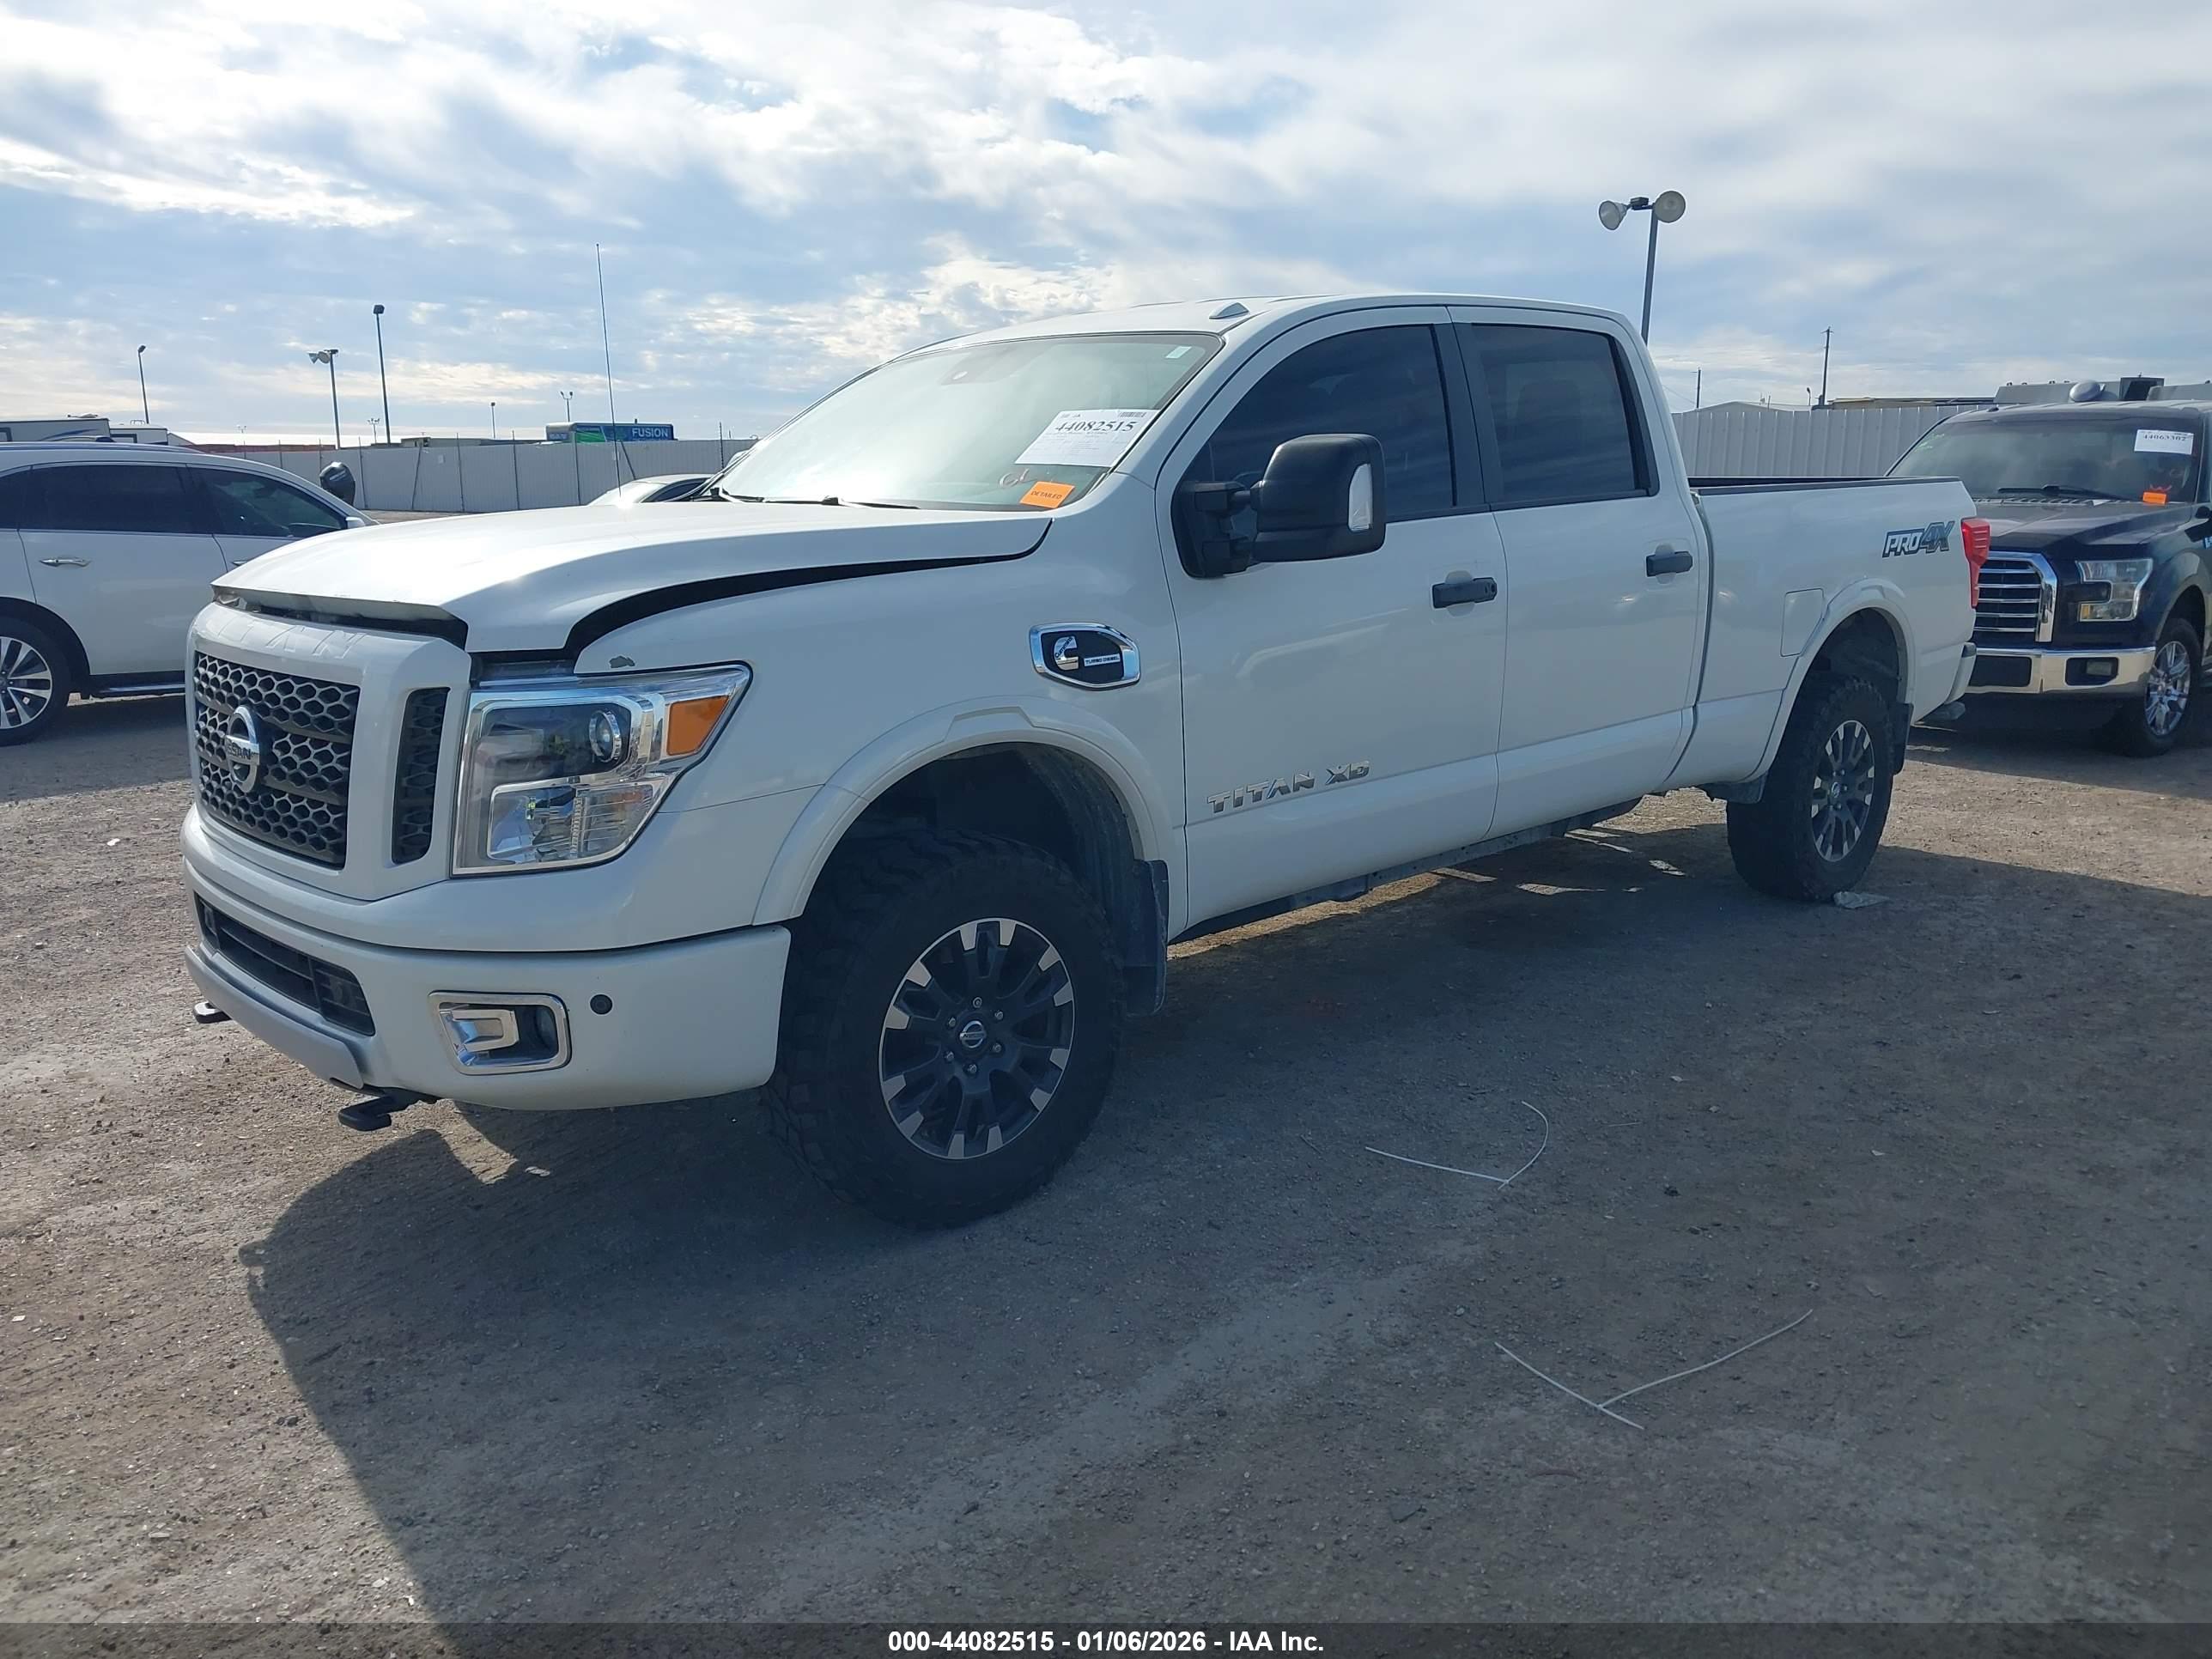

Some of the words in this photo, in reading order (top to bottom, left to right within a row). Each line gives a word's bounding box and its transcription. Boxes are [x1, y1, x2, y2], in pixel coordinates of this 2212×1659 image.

[1054, 421, 1138, 432] 44082515
[632, 428, 668, 438] FUSION
[1030, 490, 1062, 500] DETAILED
[1206, 771, 1315, 814] TITAN
[1325, 761, 1370, 785] XD
